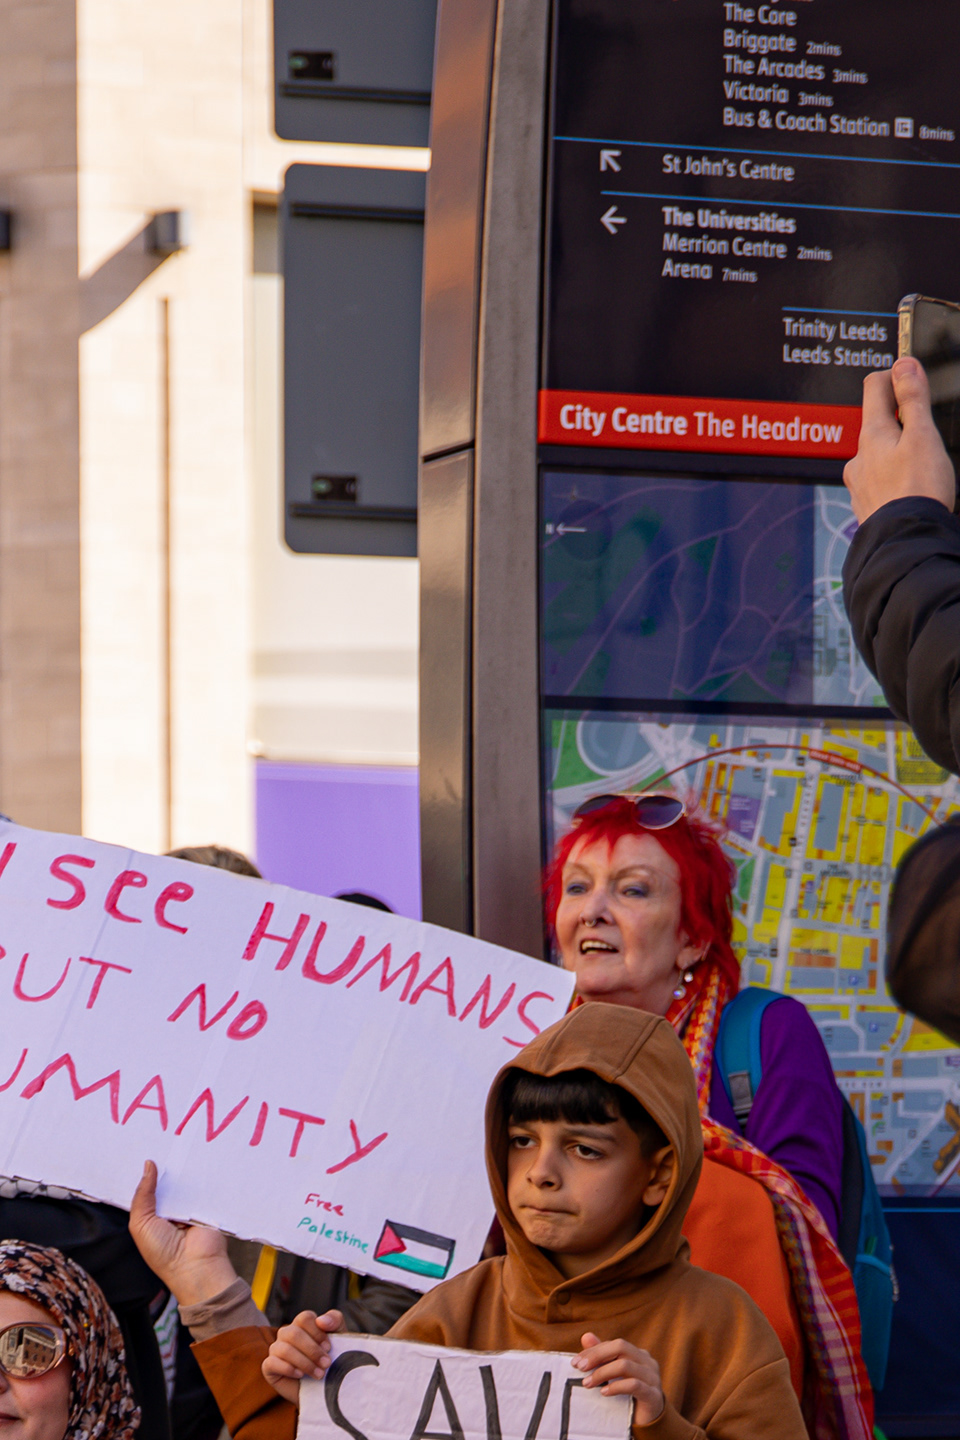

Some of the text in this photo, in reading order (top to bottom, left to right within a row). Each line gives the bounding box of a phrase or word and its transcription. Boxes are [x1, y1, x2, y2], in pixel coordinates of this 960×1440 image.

[723, 3, 797, 26] The Core
[723, 28, 797, 54] Briggate
[723, 54, 755, 75] The
[757, 57, 825, 80] Arcades
[723, 80, 789, 103] Victoria
[723, 106, 755, 128] Bus
[758, 109, 773, 128] &
[775, 110, 827, 133] Coach
[829, 113, 890, 137] Station
[662, 153, 681, 174] St
[740, 159, 795, 182] Centre
[662, 206, 797, 234] The Universities
[662, 232, 729, 255] Merrion
[732, 236, 788, 259] Centre
[661, 257, 713, 280] Arena
[783, 317, 888, 343] Trinity Leeds
[783, 344, 894, 369] Leeds Station
[560, 404, 843, 444] City Centre The Headrow
[241, 901, 554, 1049] HUMANS
[167, 983, 269, 1041] NO
[304, 1192, 344, 1216] Free
[297, 1217, 370, 1254] Palestine
